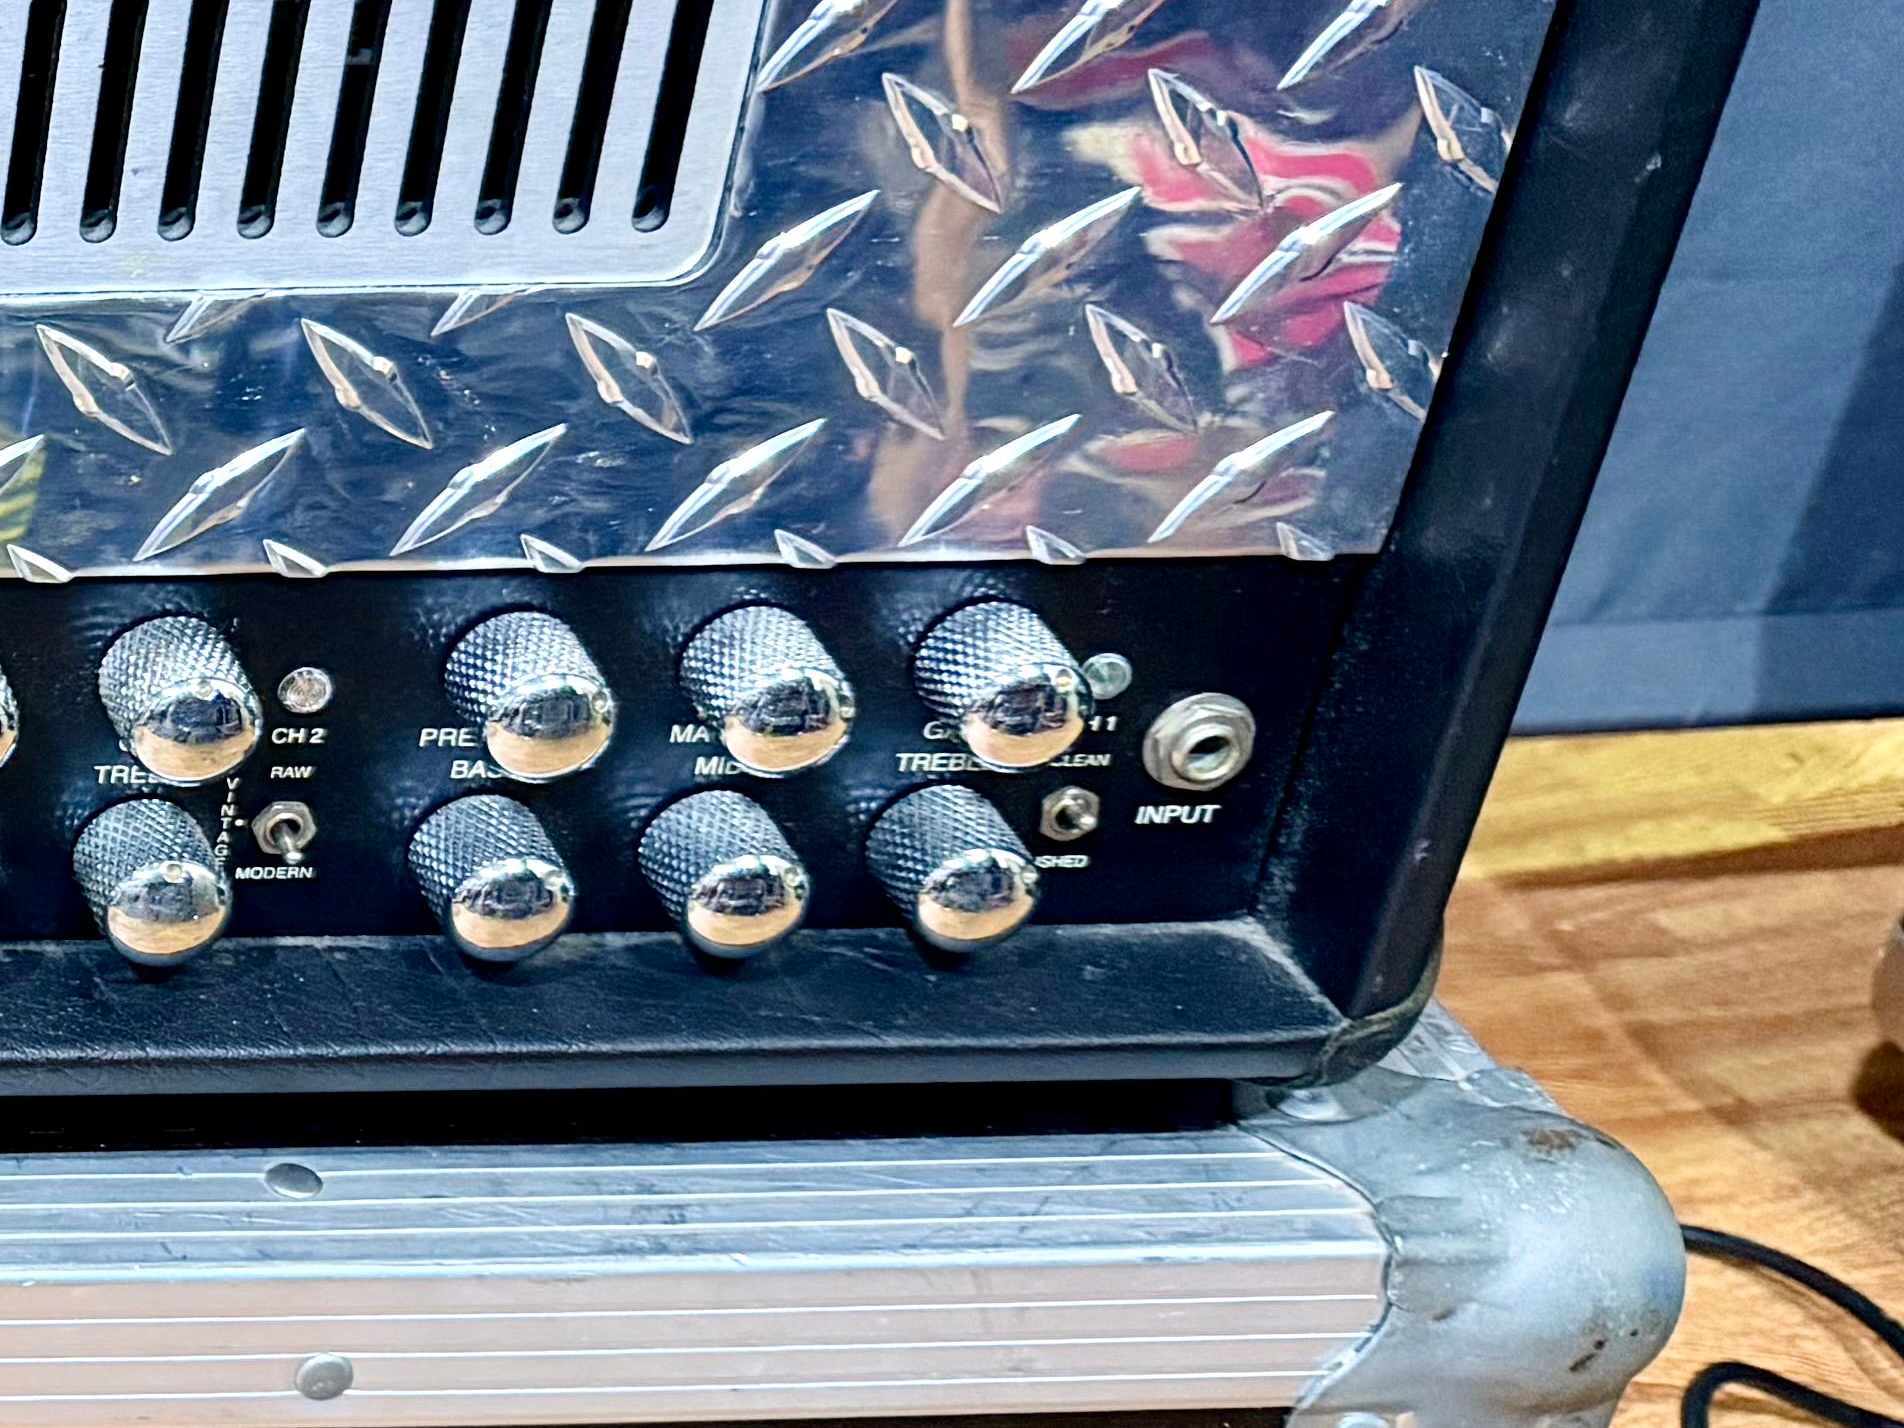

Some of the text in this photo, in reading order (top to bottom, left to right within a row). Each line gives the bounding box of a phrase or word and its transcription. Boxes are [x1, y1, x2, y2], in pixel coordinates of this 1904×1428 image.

[270, 727, 329, 745] CH 2
[269, 765, 317, 779] RAW
[1134, 803, 1223, 825] INPUT
[234, 865, 315, 880] MODERN
